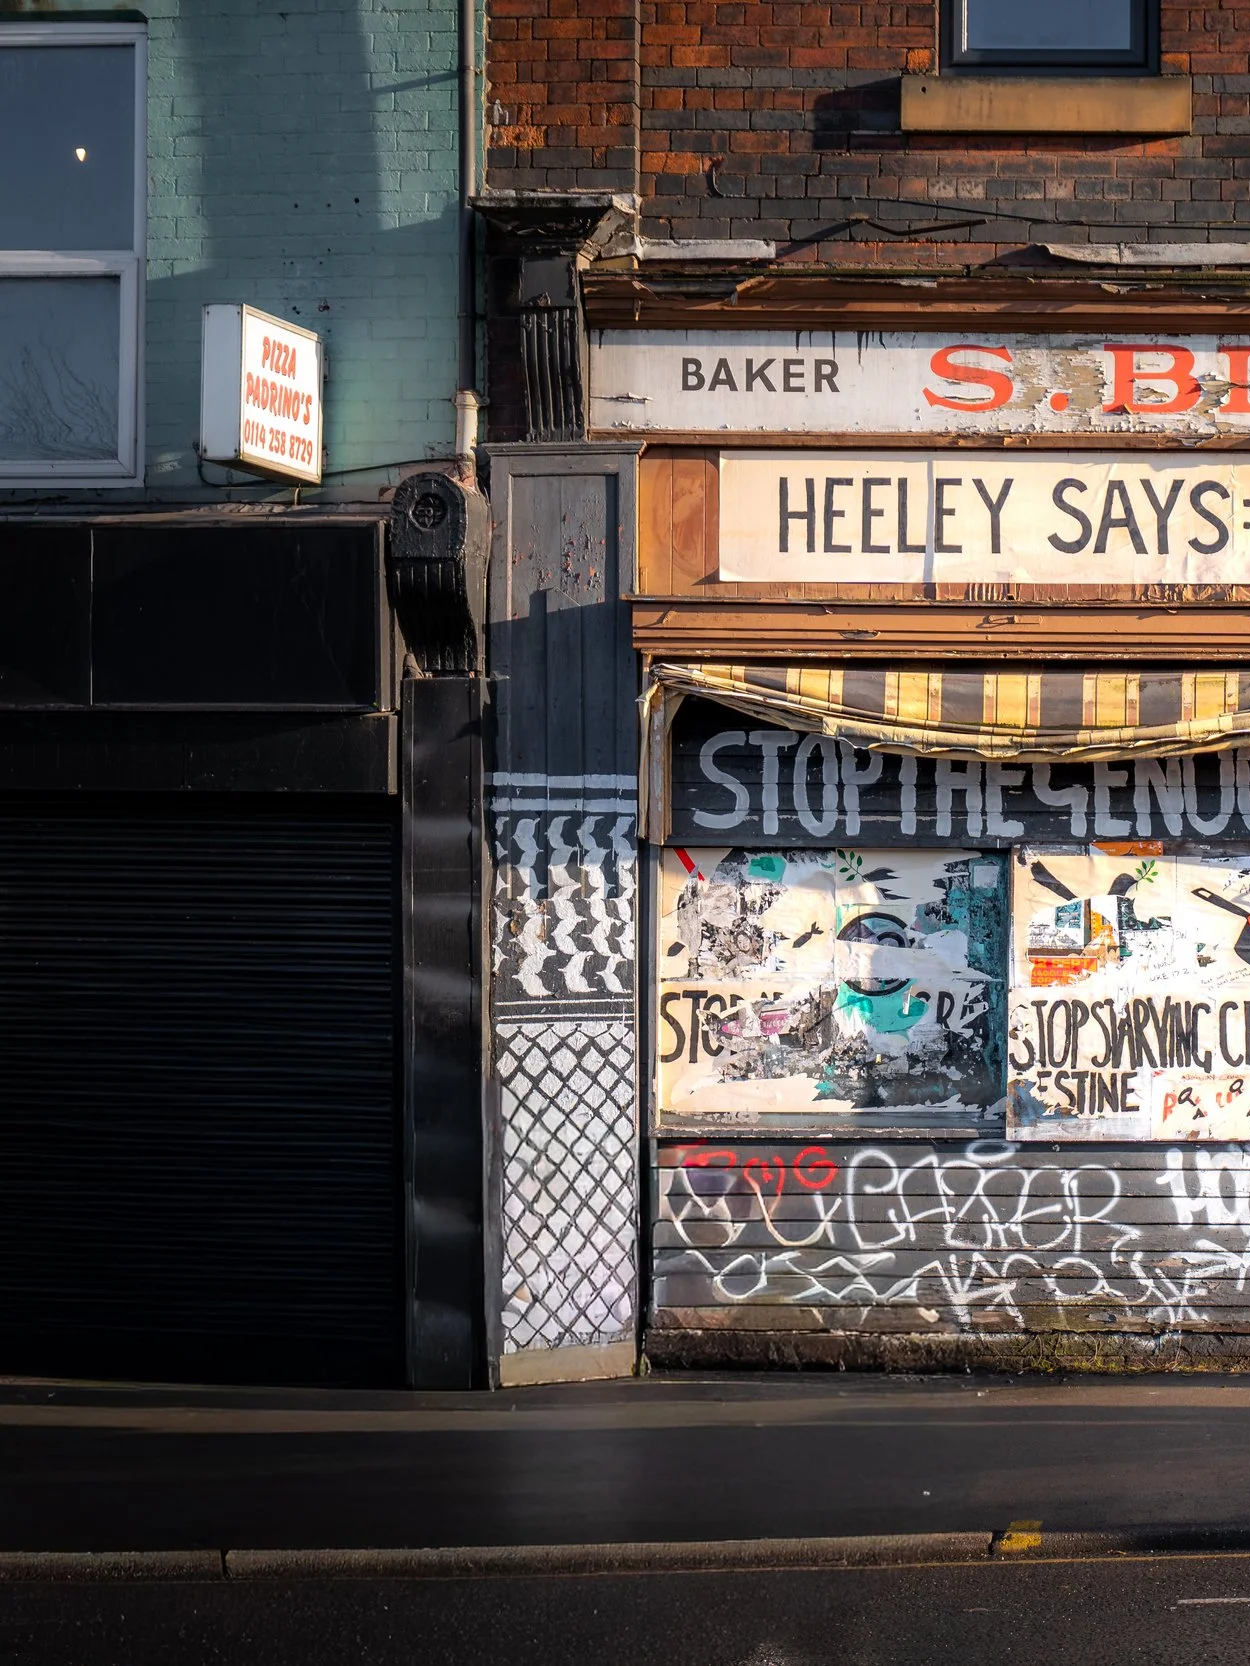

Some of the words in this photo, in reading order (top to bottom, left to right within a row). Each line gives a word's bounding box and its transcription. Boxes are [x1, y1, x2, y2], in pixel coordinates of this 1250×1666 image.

[262, 336, 297, 379] PIZZA
[681, 357, 841, 393] BAKER
[246, 372, 312, 425] PADRINO'S
[244, 419, 266, 449] 0114
[269, 427, 286, 456] 258
[289, 435, 313, 465] 8729
[778, 476, 1015, 554] HEELEY
[693, 730, 884, 837] STOP
